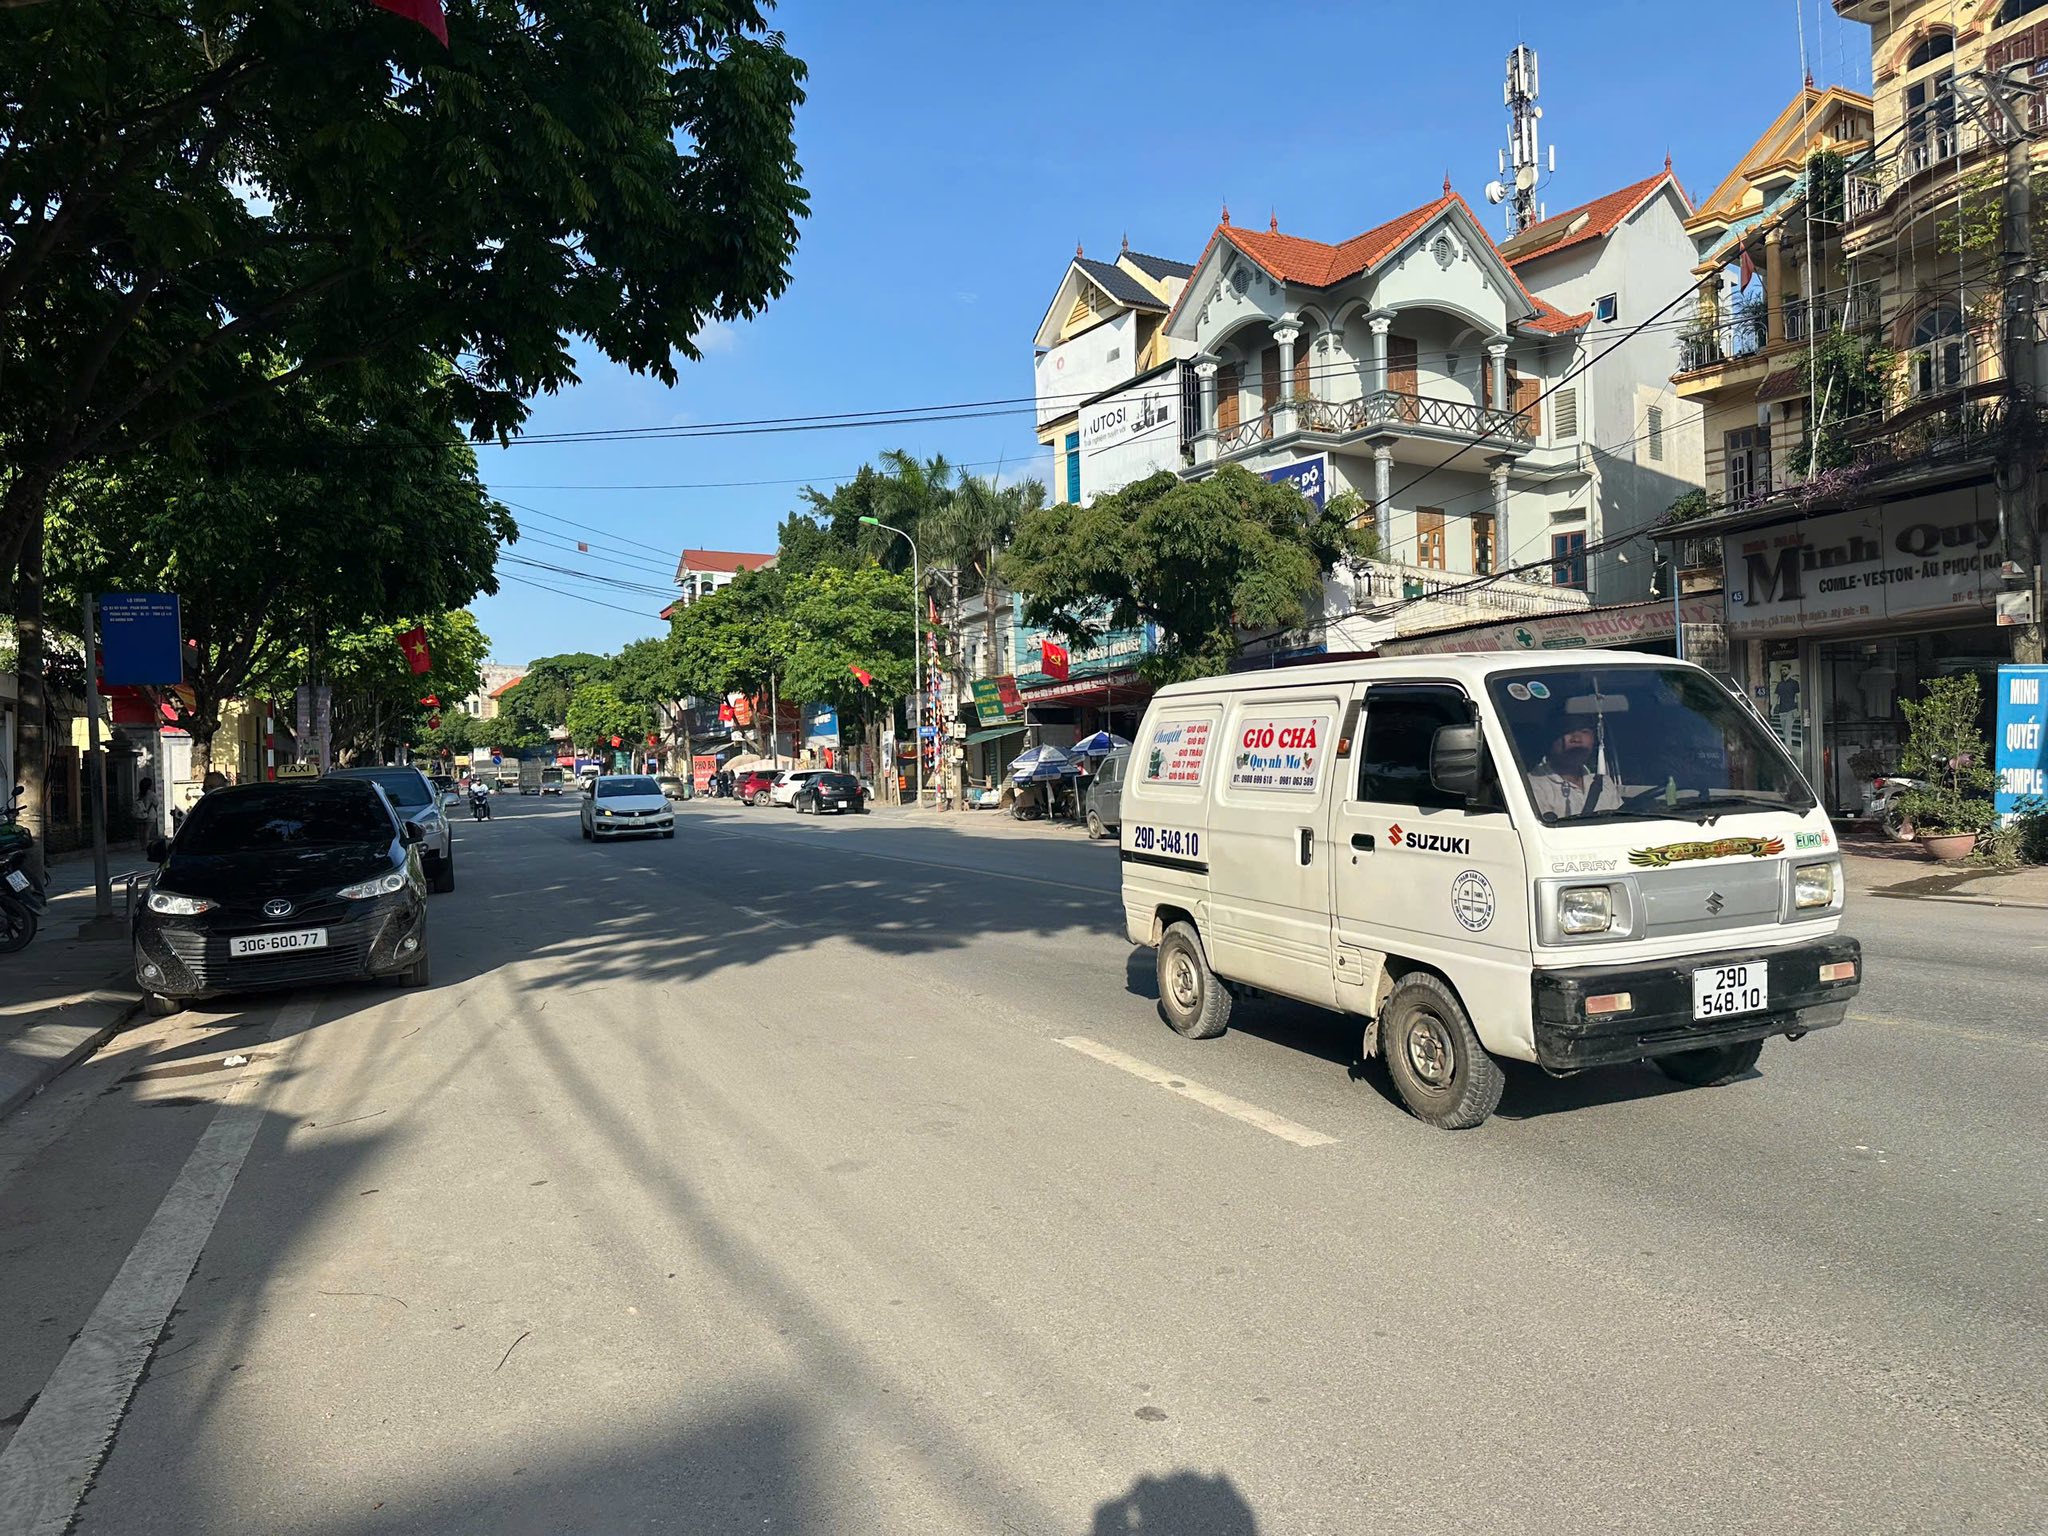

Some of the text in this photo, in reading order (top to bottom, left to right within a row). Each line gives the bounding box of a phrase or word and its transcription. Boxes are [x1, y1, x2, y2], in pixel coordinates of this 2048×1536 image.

[1742, 536, 1881, 607] Minh
[1581, 610, 1645, 637] THUỐC
[2010, 679, 2038, 705] MINH
[1243, 719, 1317, 749] GIÒ CHẢ
[2007, 715, 2040, 752] QUYẾT
[282, 764, 310, 774] TAXI
[2000, 768, 2043, 795] COMPLE
[1406, 832, 1470, 855] SUZUKI
[1552, 859, 1617, 873] CARRY
[239, 932, 318, 953] 30G-600.77
[1716, 967, 1747, 991] 29D
[1703, 988, 1760, 1016] 548.10
